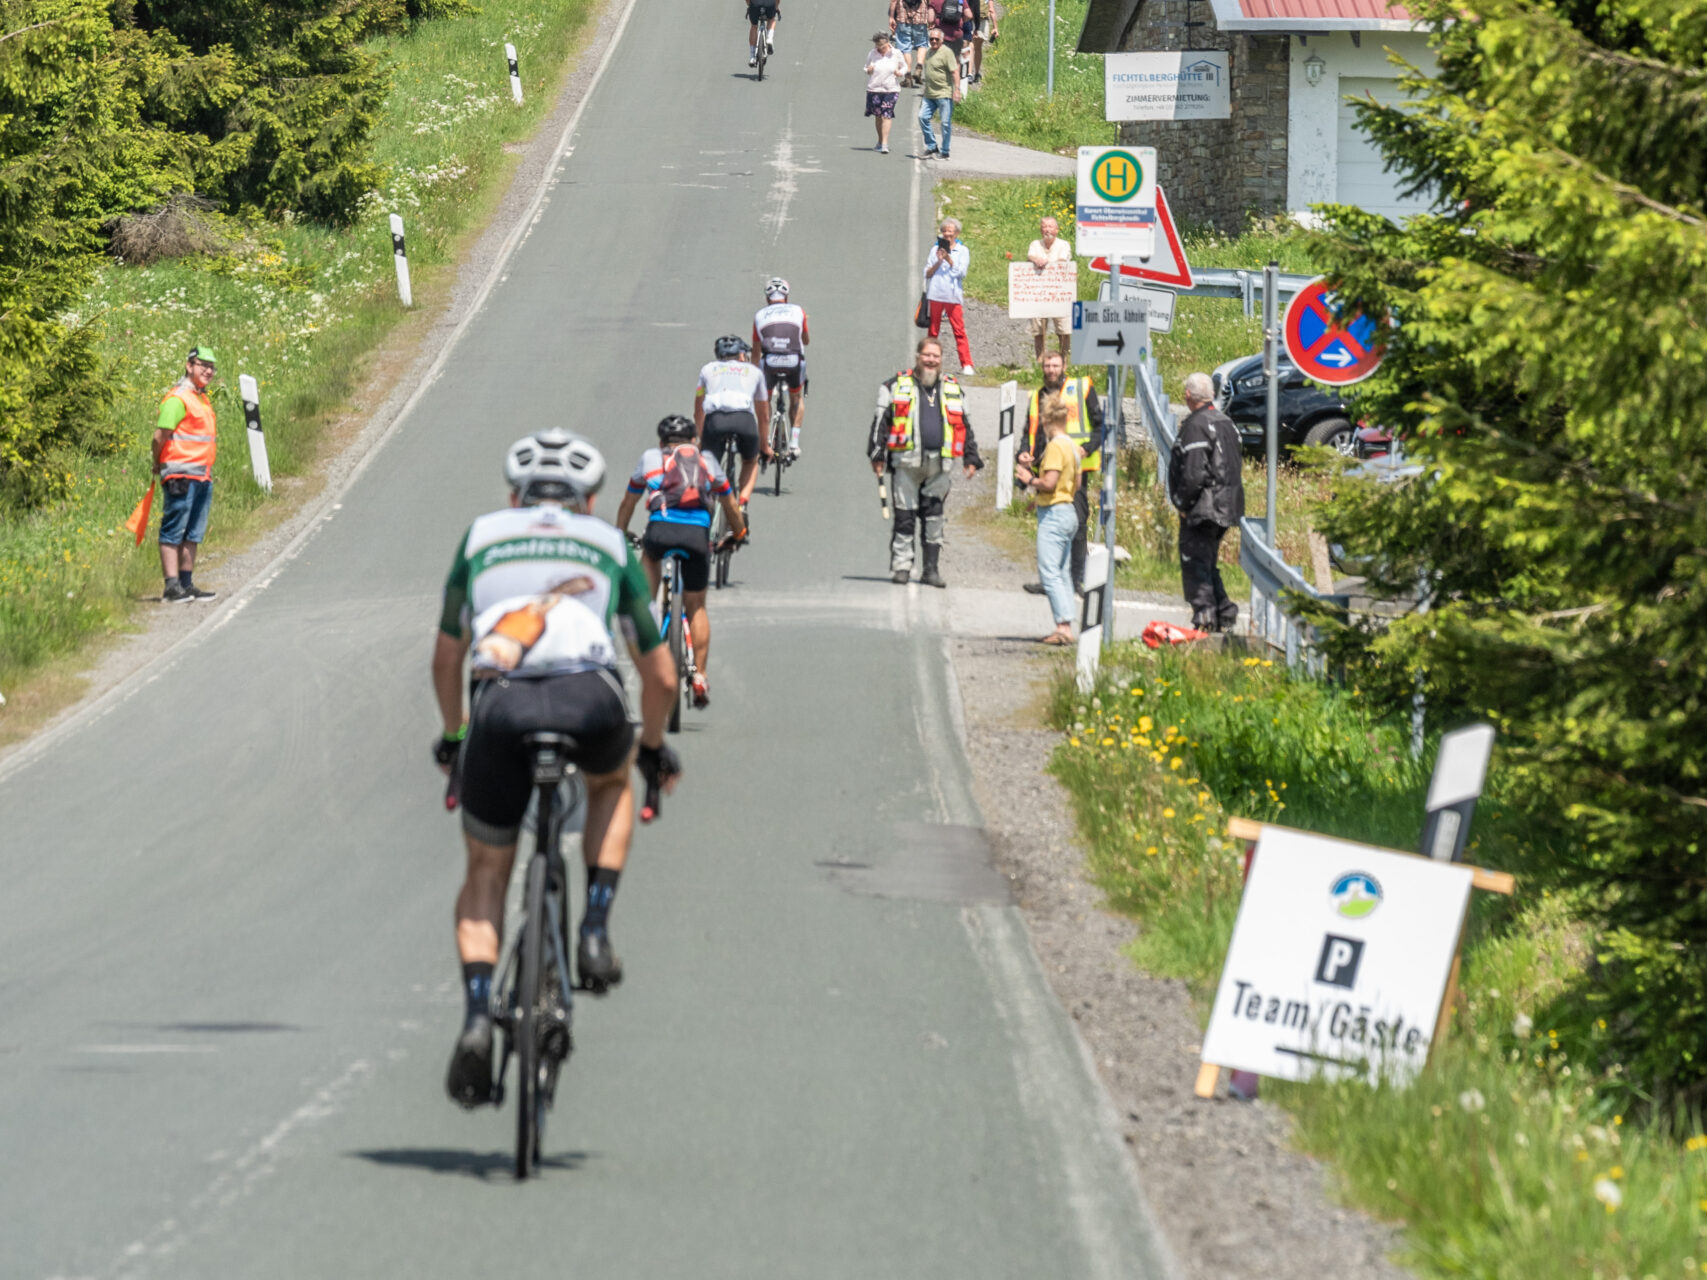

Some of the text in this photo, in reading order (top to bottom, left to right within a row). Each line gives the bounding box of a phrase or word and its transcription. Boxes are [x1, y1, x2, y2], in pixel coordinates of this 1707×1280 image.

[1112, 71, 1203, 82] FICHTELBERGHÜTTE
[1106, 162, 1127, 191] H
[1322, 938, 1354, 982] P
[1233, 980, 1421, 1056] Team Gäste
